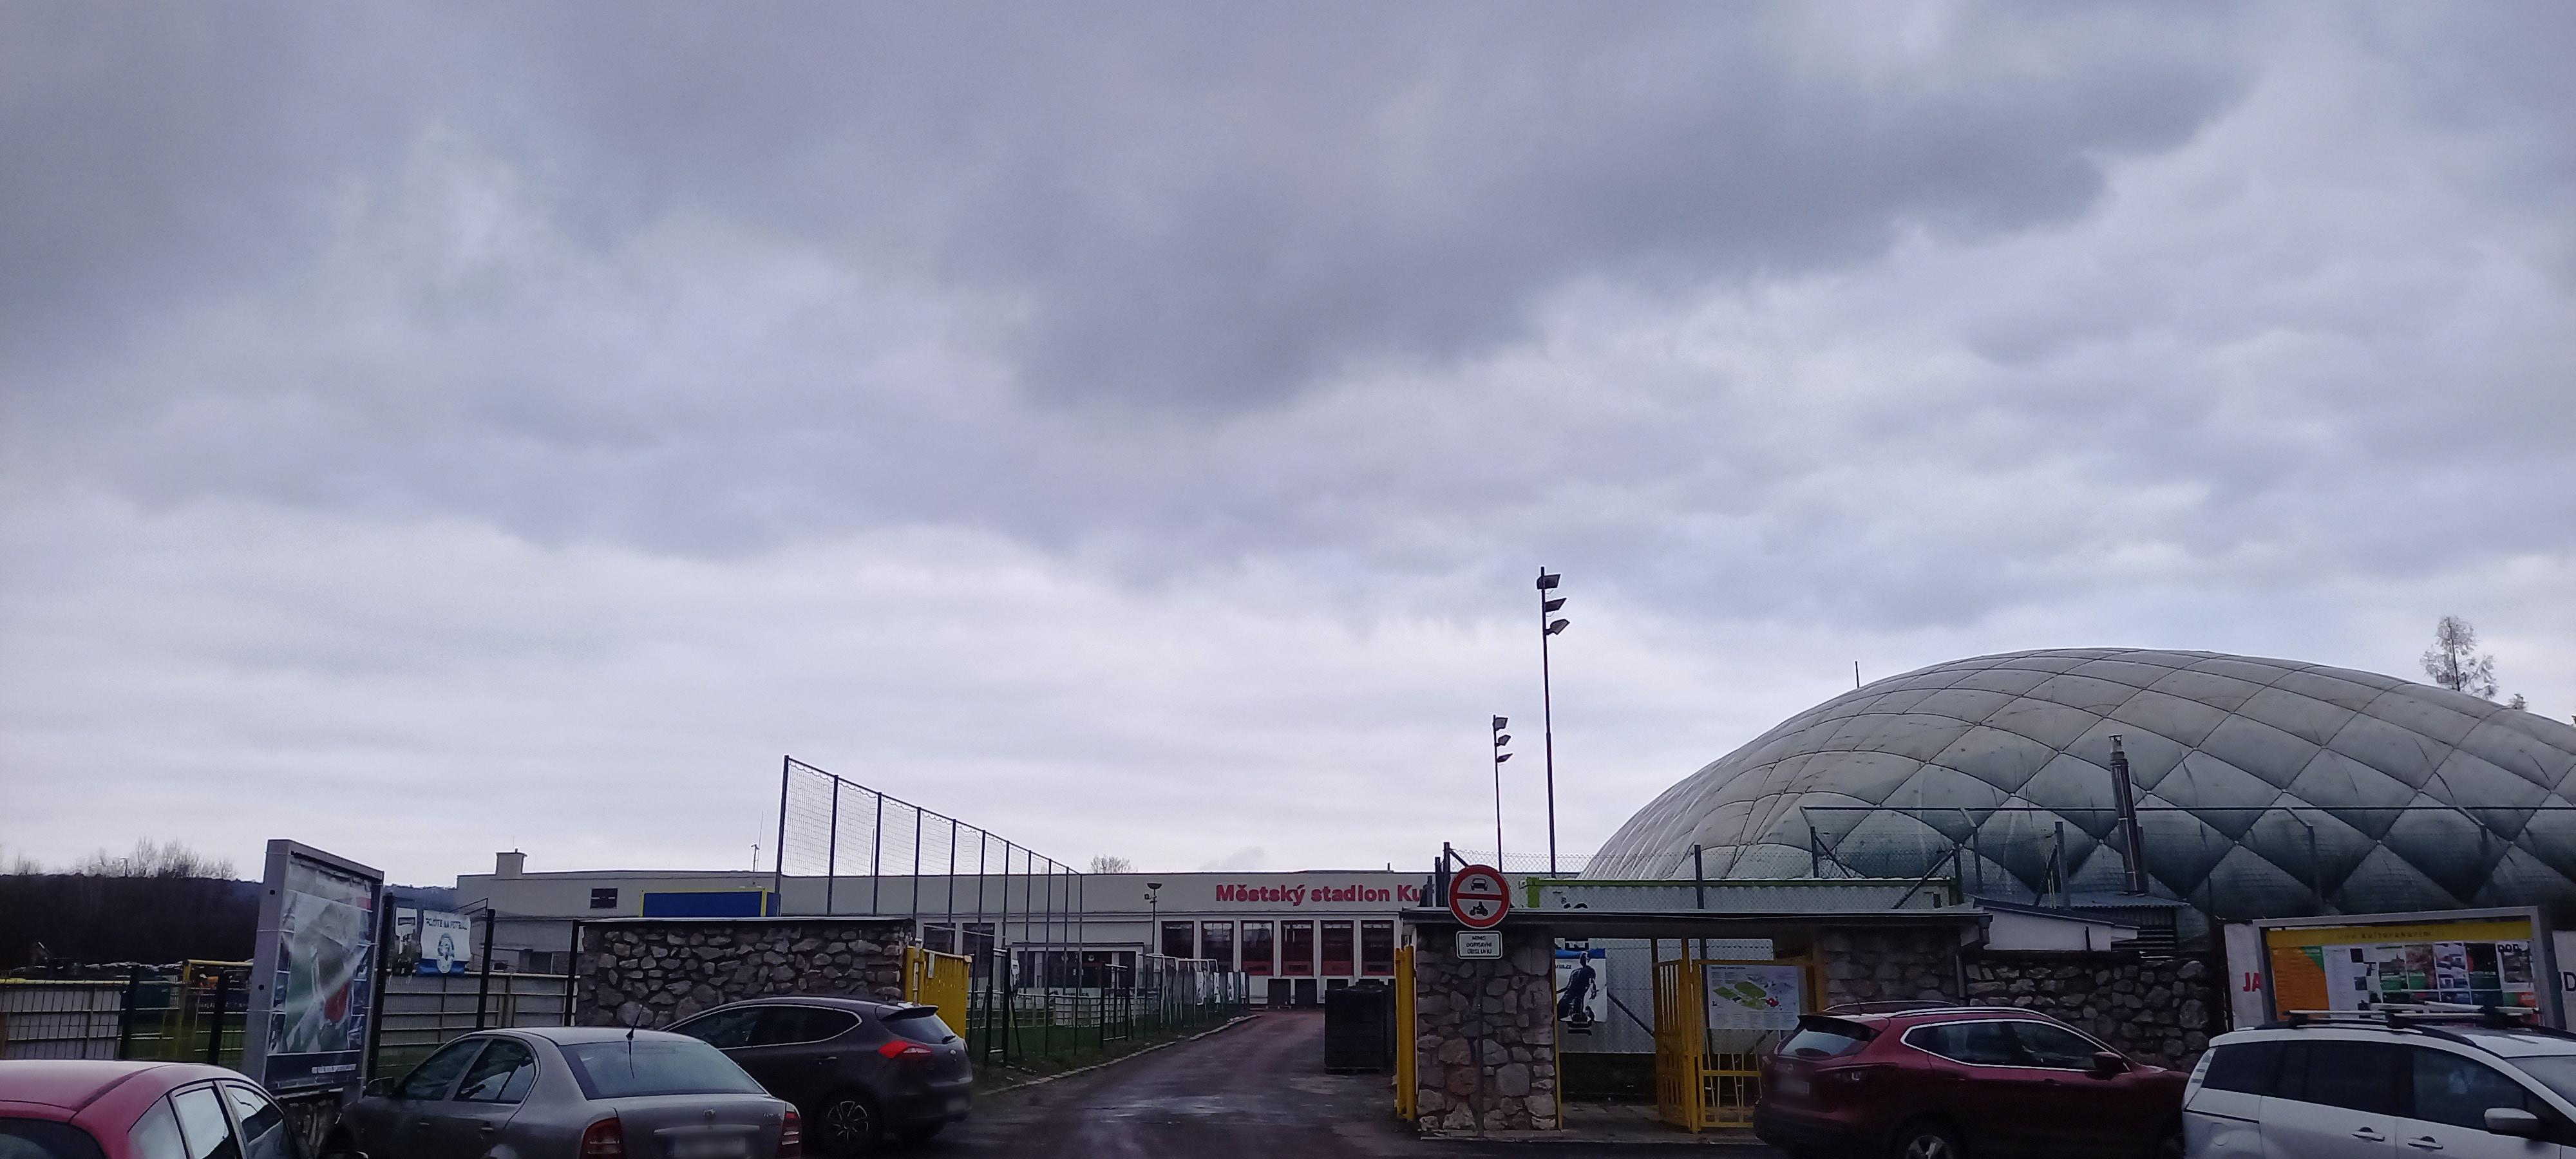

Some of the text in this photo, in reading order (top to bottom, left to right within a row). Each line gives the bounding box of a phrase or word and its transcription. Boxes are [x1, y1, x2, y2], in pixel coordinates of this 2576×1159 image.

[1217, 884, 1435, 906] Městský stadion Ku
